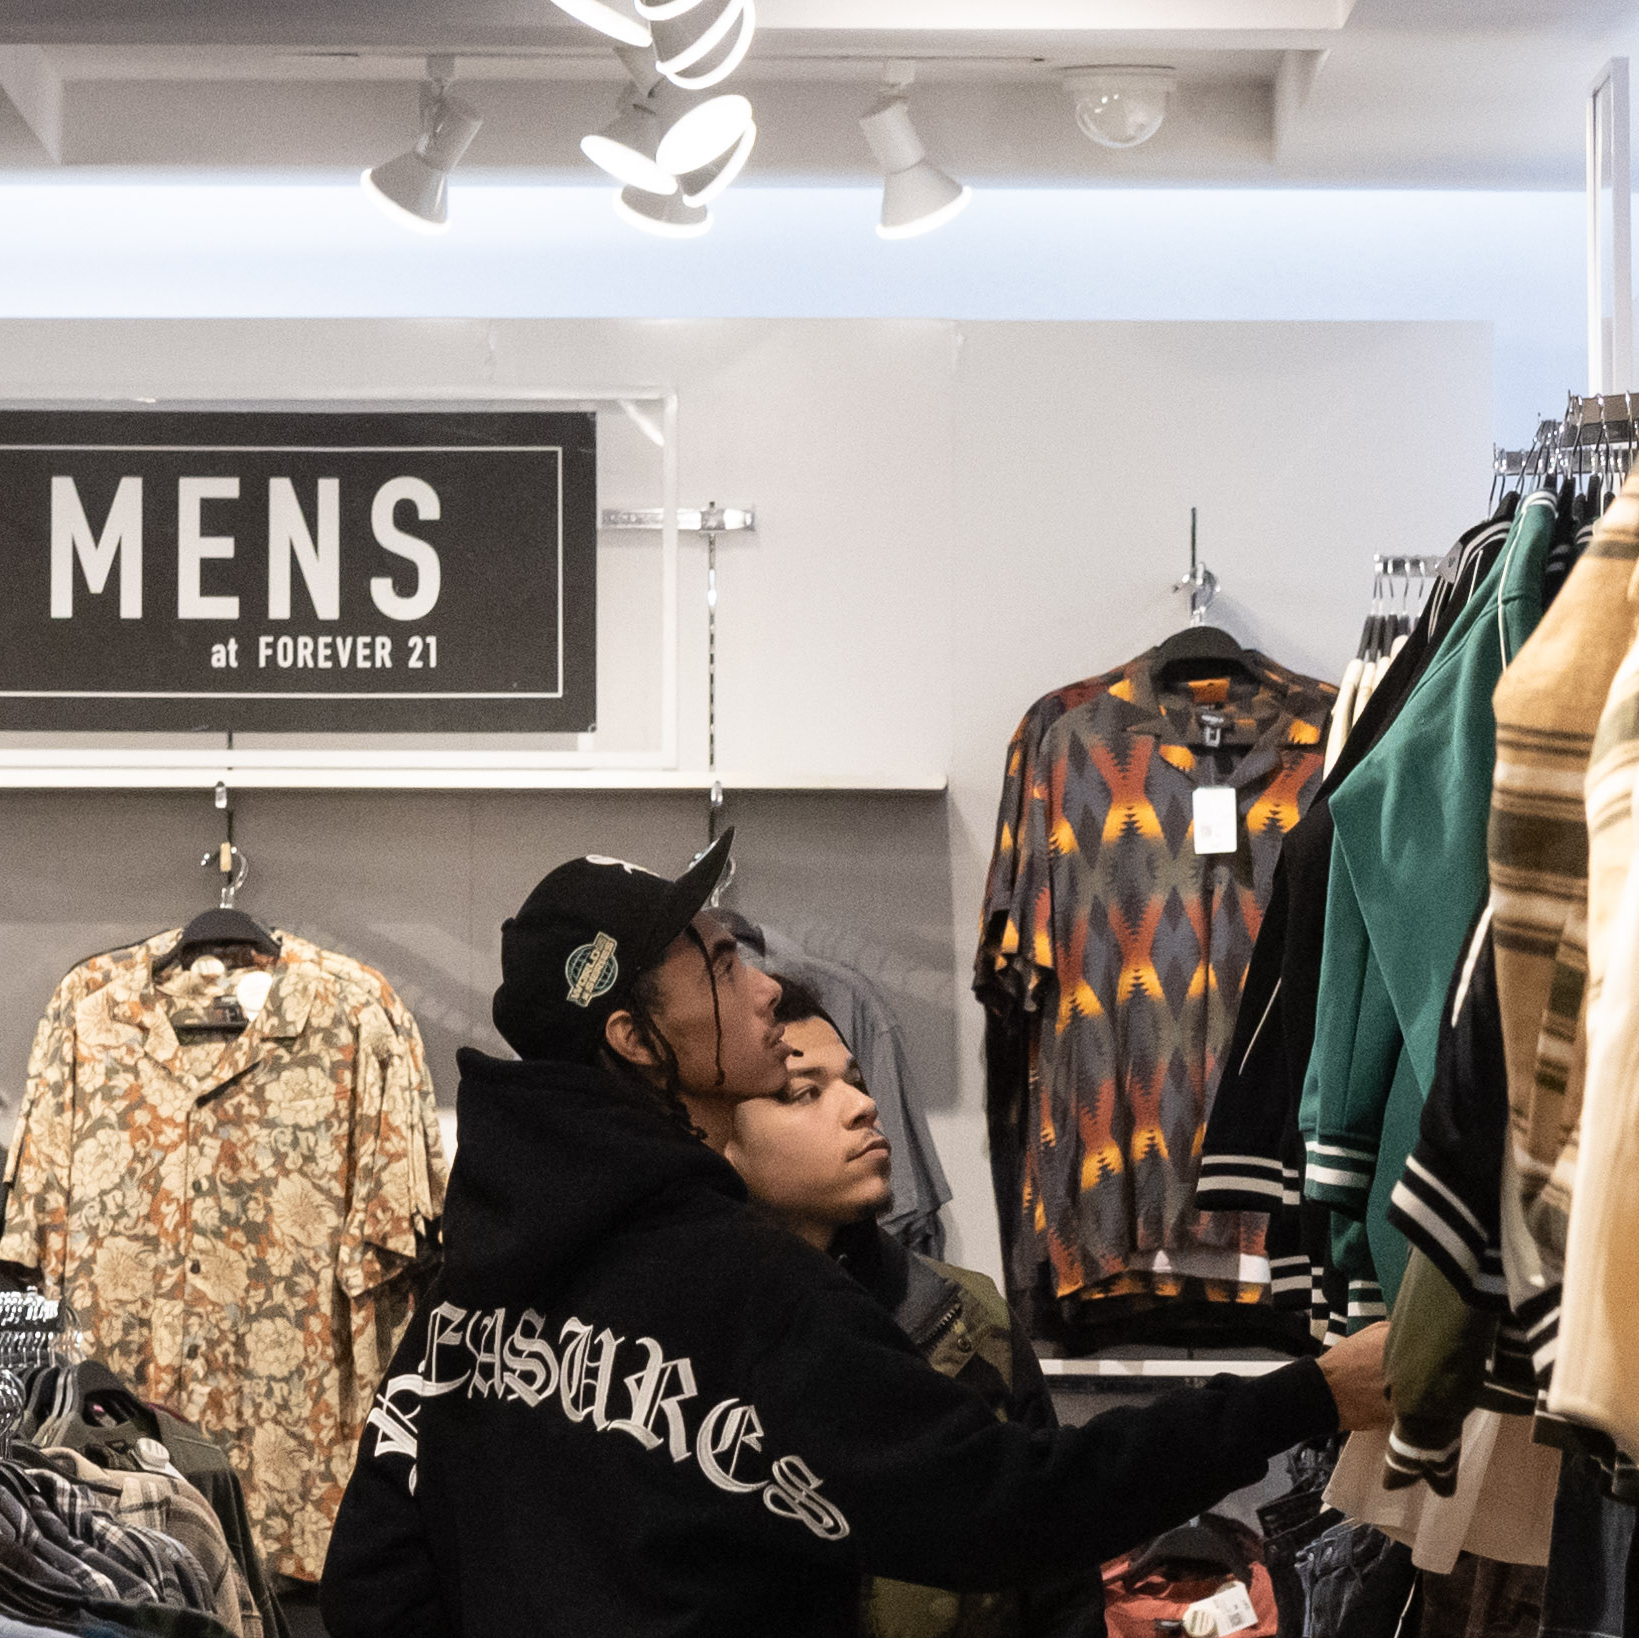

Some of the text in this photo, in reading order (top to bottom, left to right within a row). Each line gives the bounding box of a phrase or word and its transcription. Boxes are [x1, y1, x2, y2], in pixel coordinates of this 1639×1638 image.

[51, 476, 441, 621] MENS
[210, 636, 438, 669] at FOREVER 21
